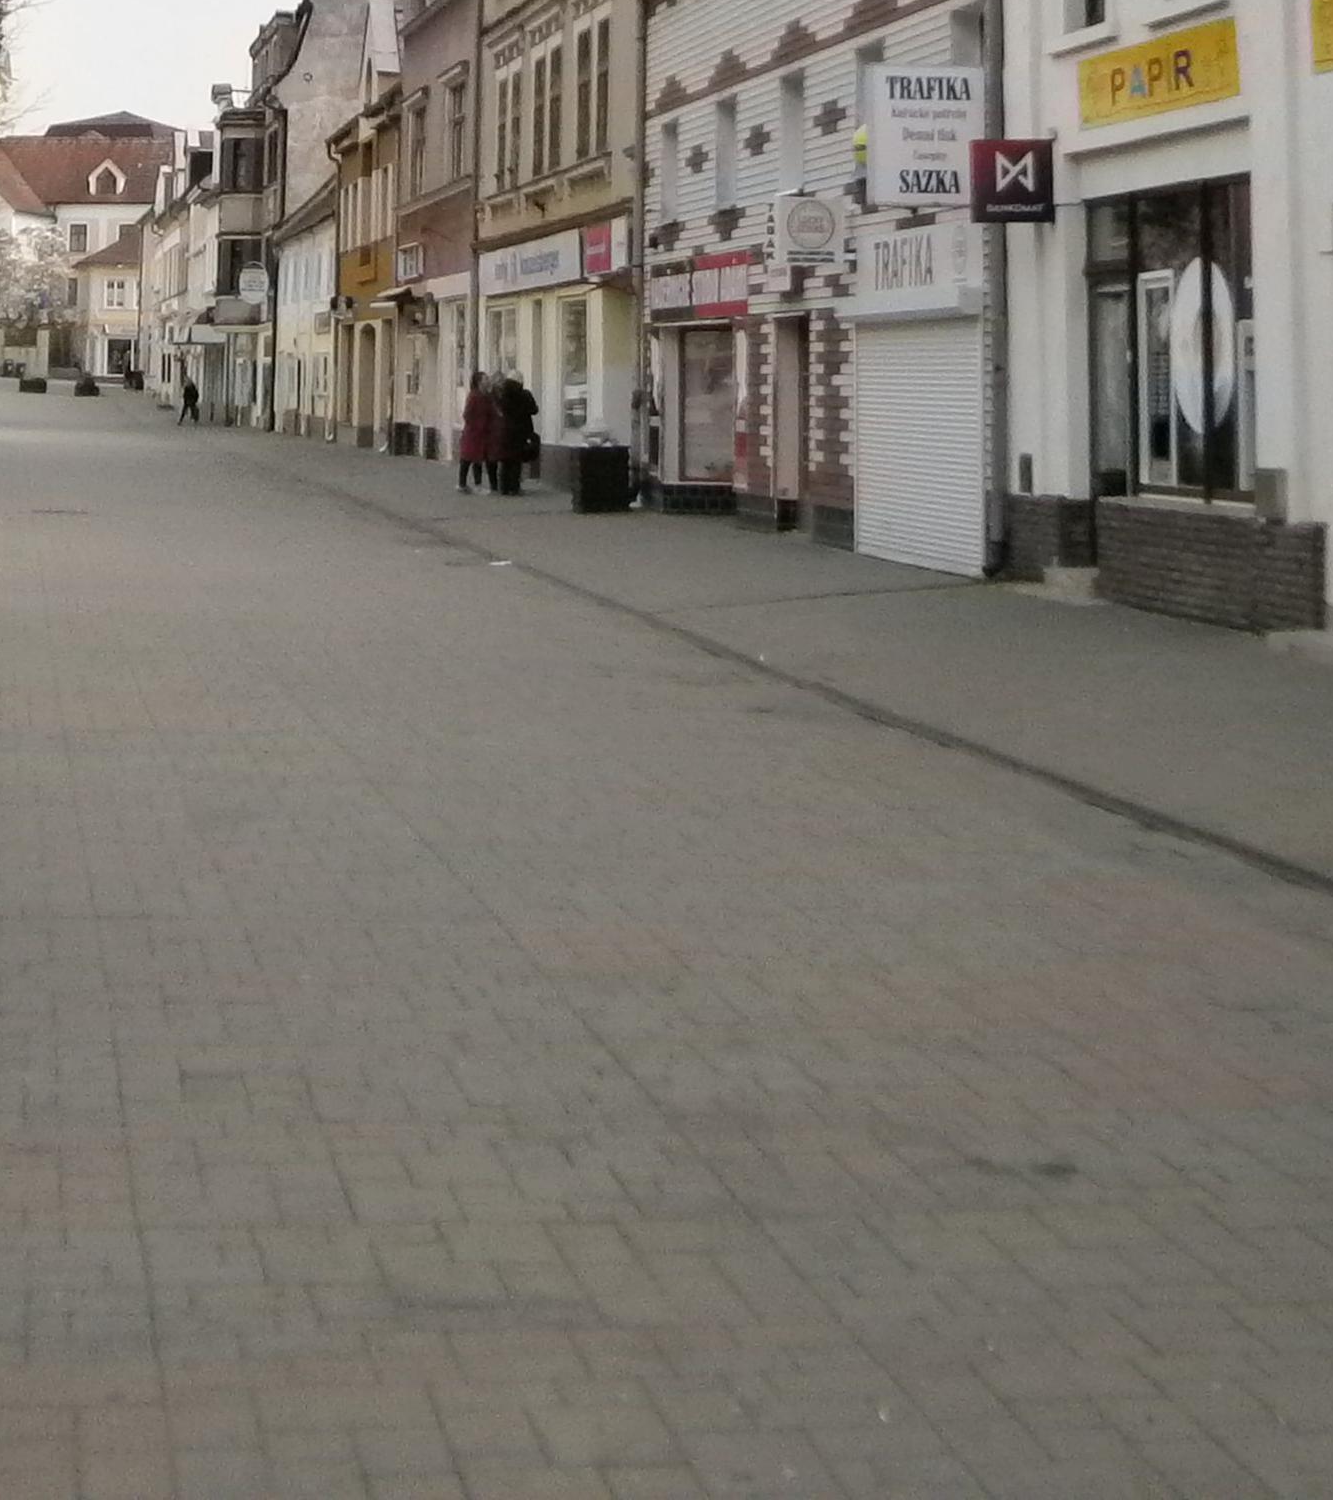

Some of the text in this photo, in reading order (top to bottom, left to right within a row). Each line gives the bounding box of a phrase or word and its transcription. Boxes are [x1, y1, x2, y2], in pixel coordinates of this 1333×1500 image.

[885, 75, 971, 101] TRAFIKA
[1110, 48, 1195, 107] PAPR
[898, 168, 961, 195] SAZKA
[873, 232, 934, 292] TRAFIKA
